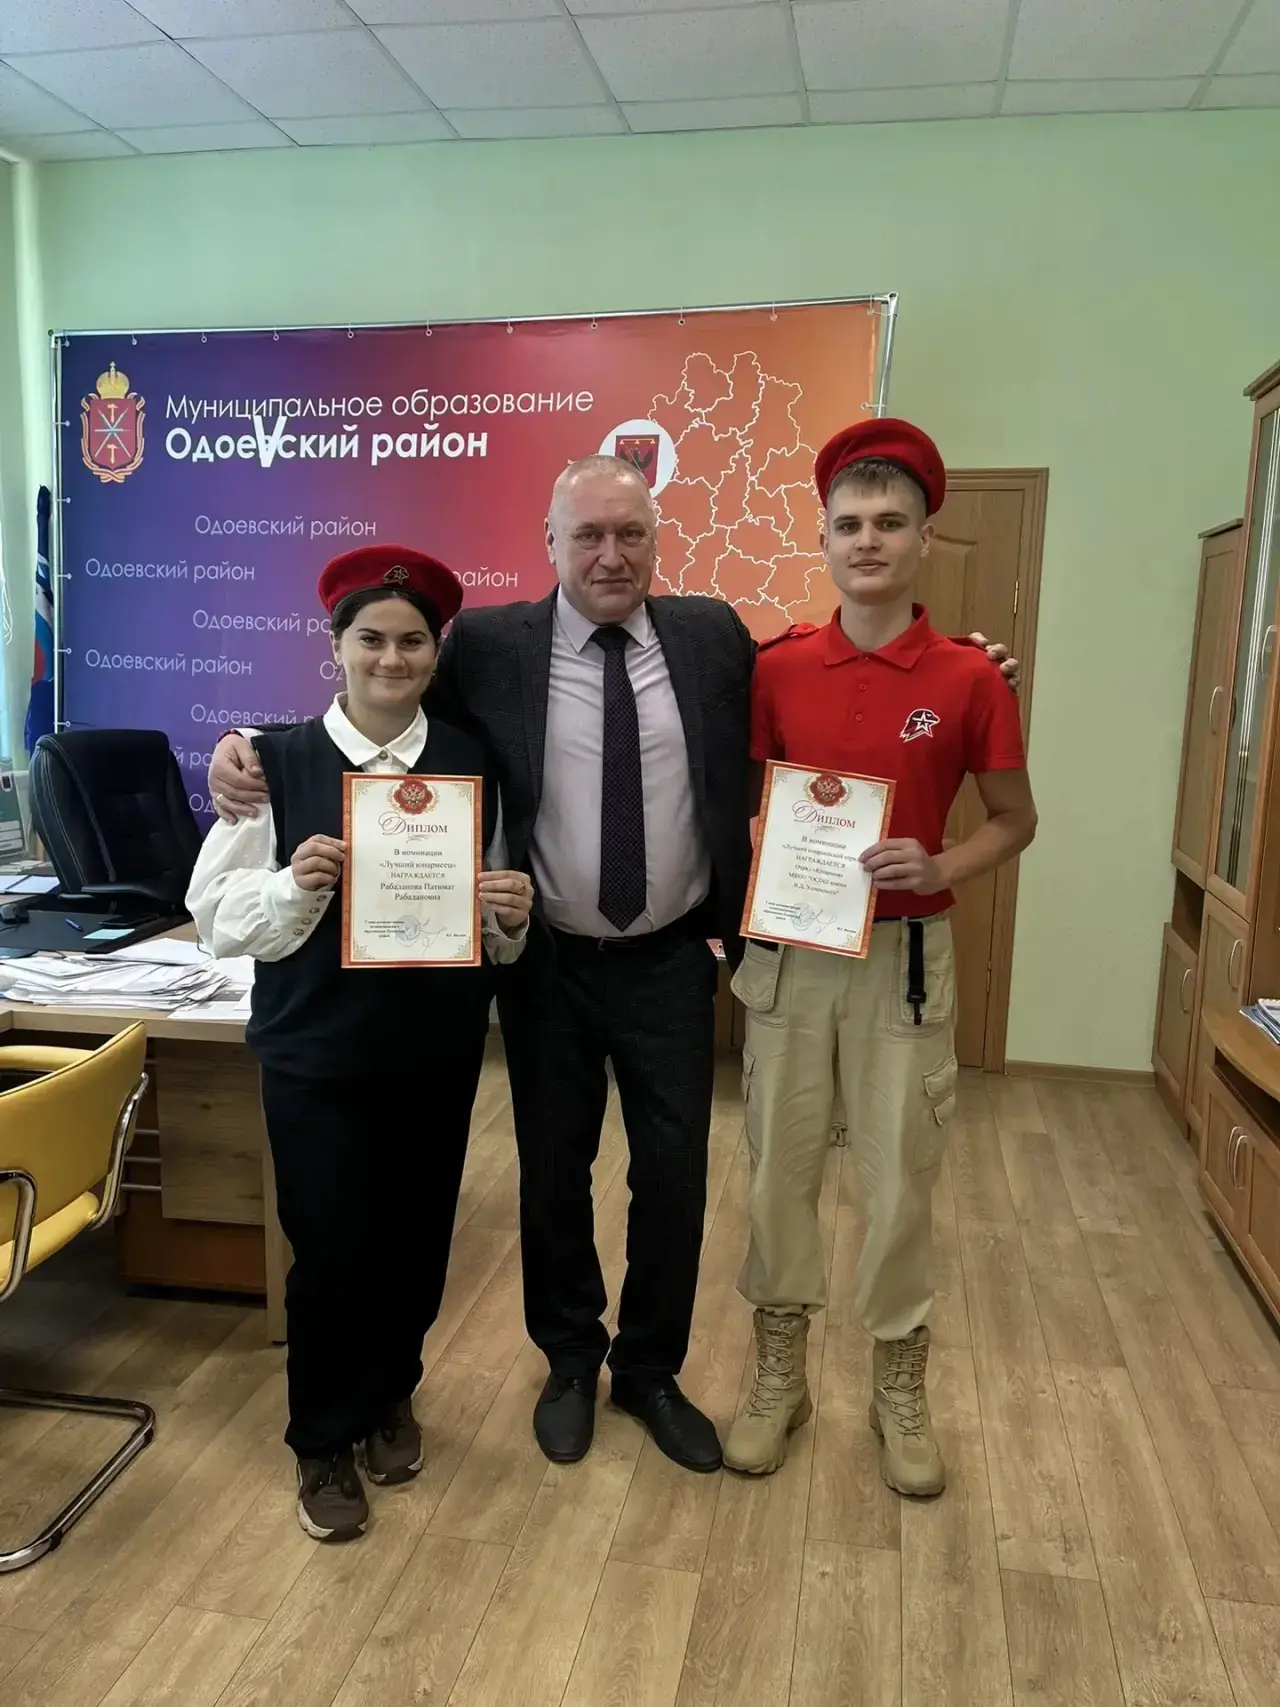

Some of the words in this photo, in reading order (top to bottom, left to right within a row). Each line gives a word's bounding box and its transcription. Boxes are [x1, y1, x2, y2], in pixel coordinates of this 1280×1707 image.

[165, 394, 383, 424] Муниципальное
[392, 388, 594, 421] образование
[371, 422, 488, 466] район
[195, 515, 304, 536] Одоевский
[310, 516, 377, 540] район
[85, 558, 188, 579] Одоевский
[193, 560, 255, 584] район
[192, 609, 301, 632] Одоевский
[85, 648, 187, 671] Одоевский
[191, 655, 252, 677] район
[190, 703, 297, 725] Одоевский
